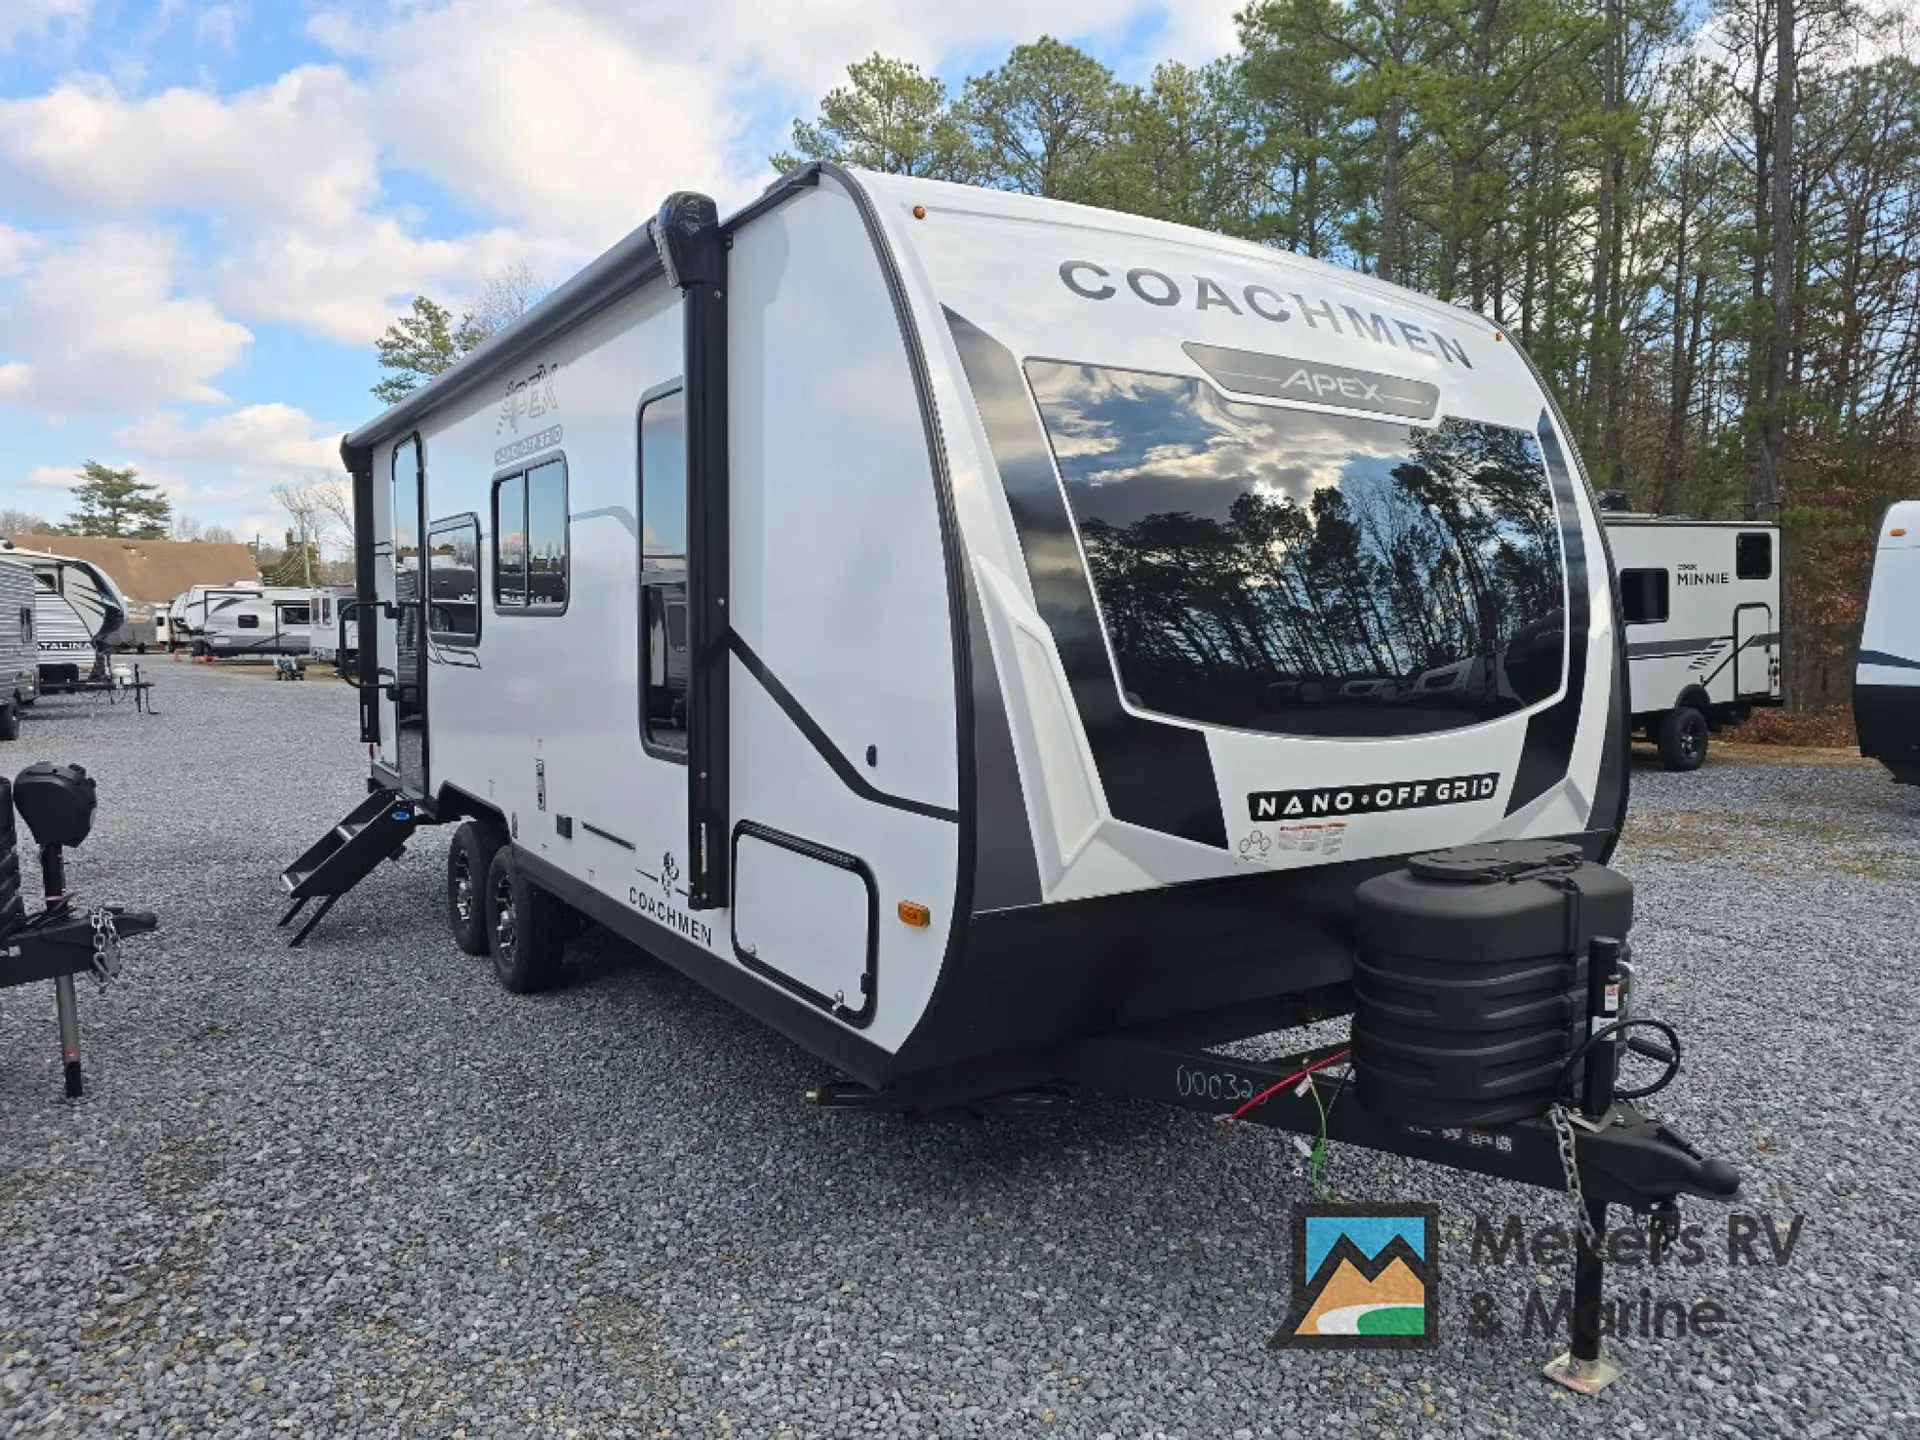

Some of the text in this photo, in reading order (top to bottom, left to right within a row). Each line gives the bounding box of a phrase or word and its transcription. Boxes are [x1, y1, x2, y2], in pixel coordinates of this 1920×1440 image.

[1058, 259, 1474, 370] COACHMEN
[1281, 368, 1385, 404] APEX
[1677, 572, 1730, 586] MINNIE
[1257, 776, 1495, 818] NANO OFF GRID
[628, 886, 712, 947] COACHMEN
